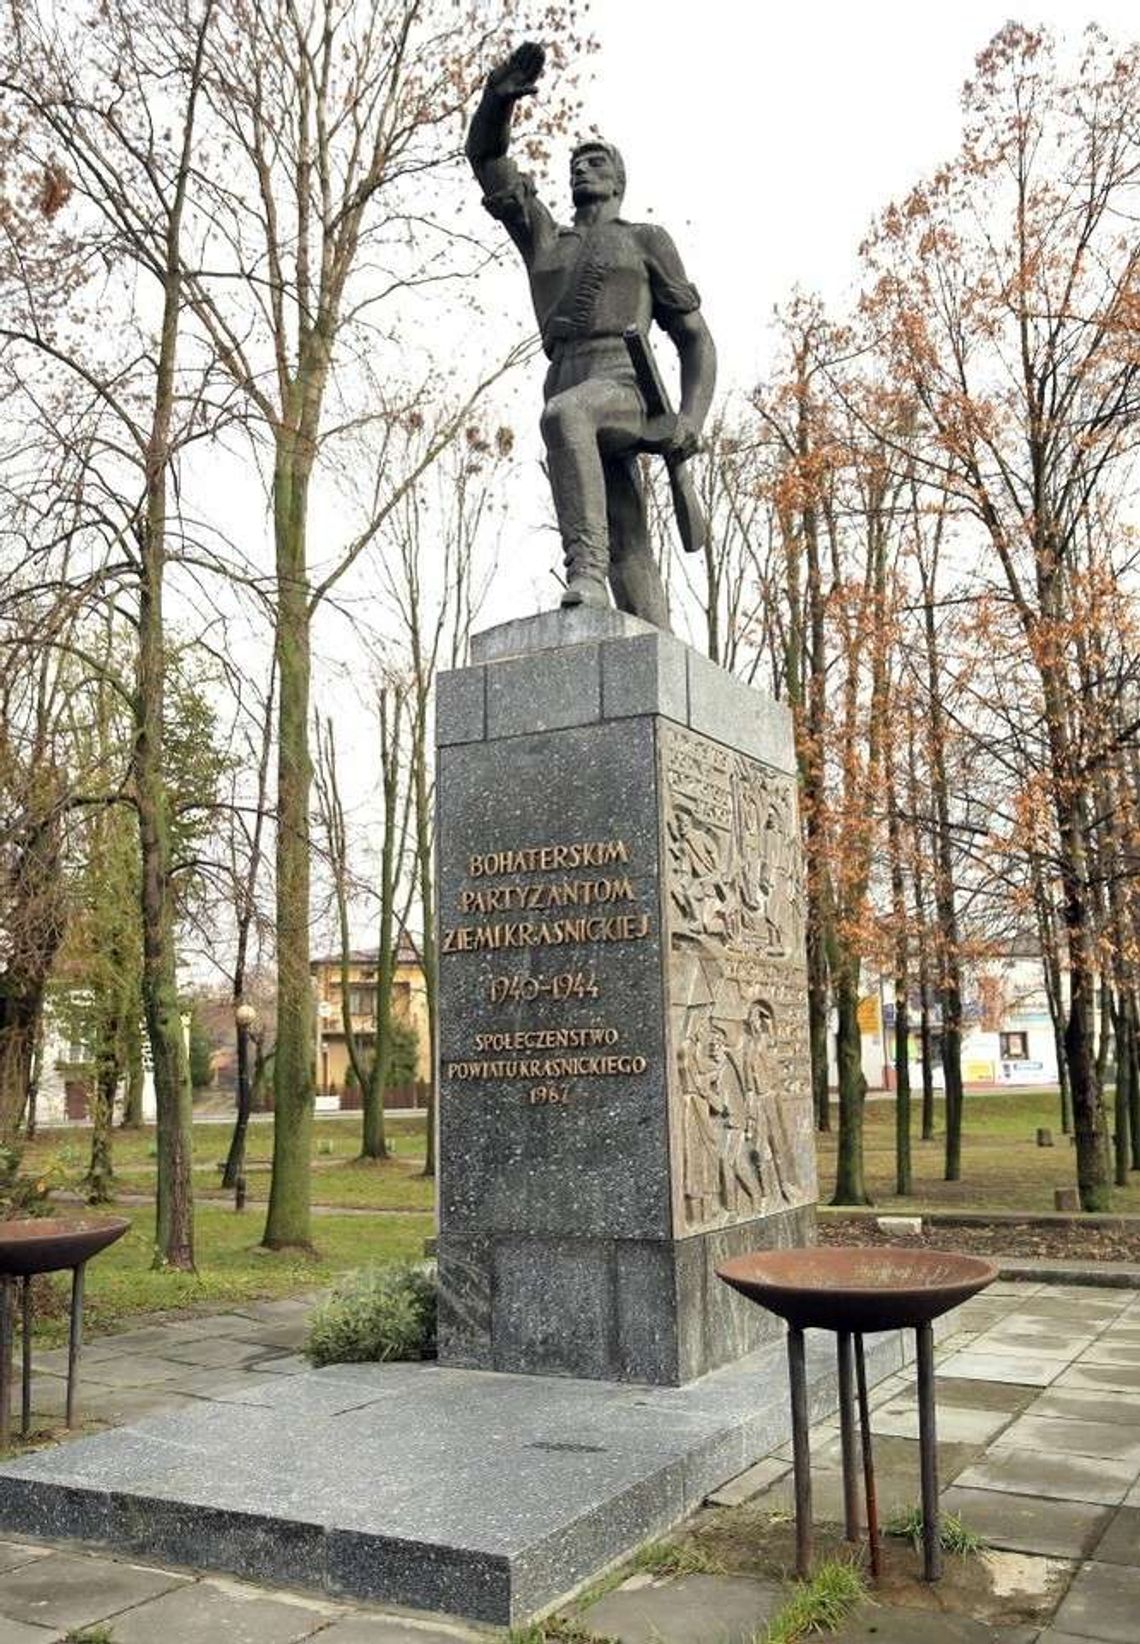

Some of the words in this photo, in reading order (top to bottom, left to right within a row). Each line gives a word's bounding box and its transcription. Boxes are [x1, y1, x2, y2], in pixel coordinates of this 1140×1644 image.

[469, 840, 629, 877] BOHATERSKIM
[461, 878, 635, 913] PARTYZANTOM
[442, 926, 500, 953] ZIEMI
[448, 1060, 517, 1080] POWIATU
